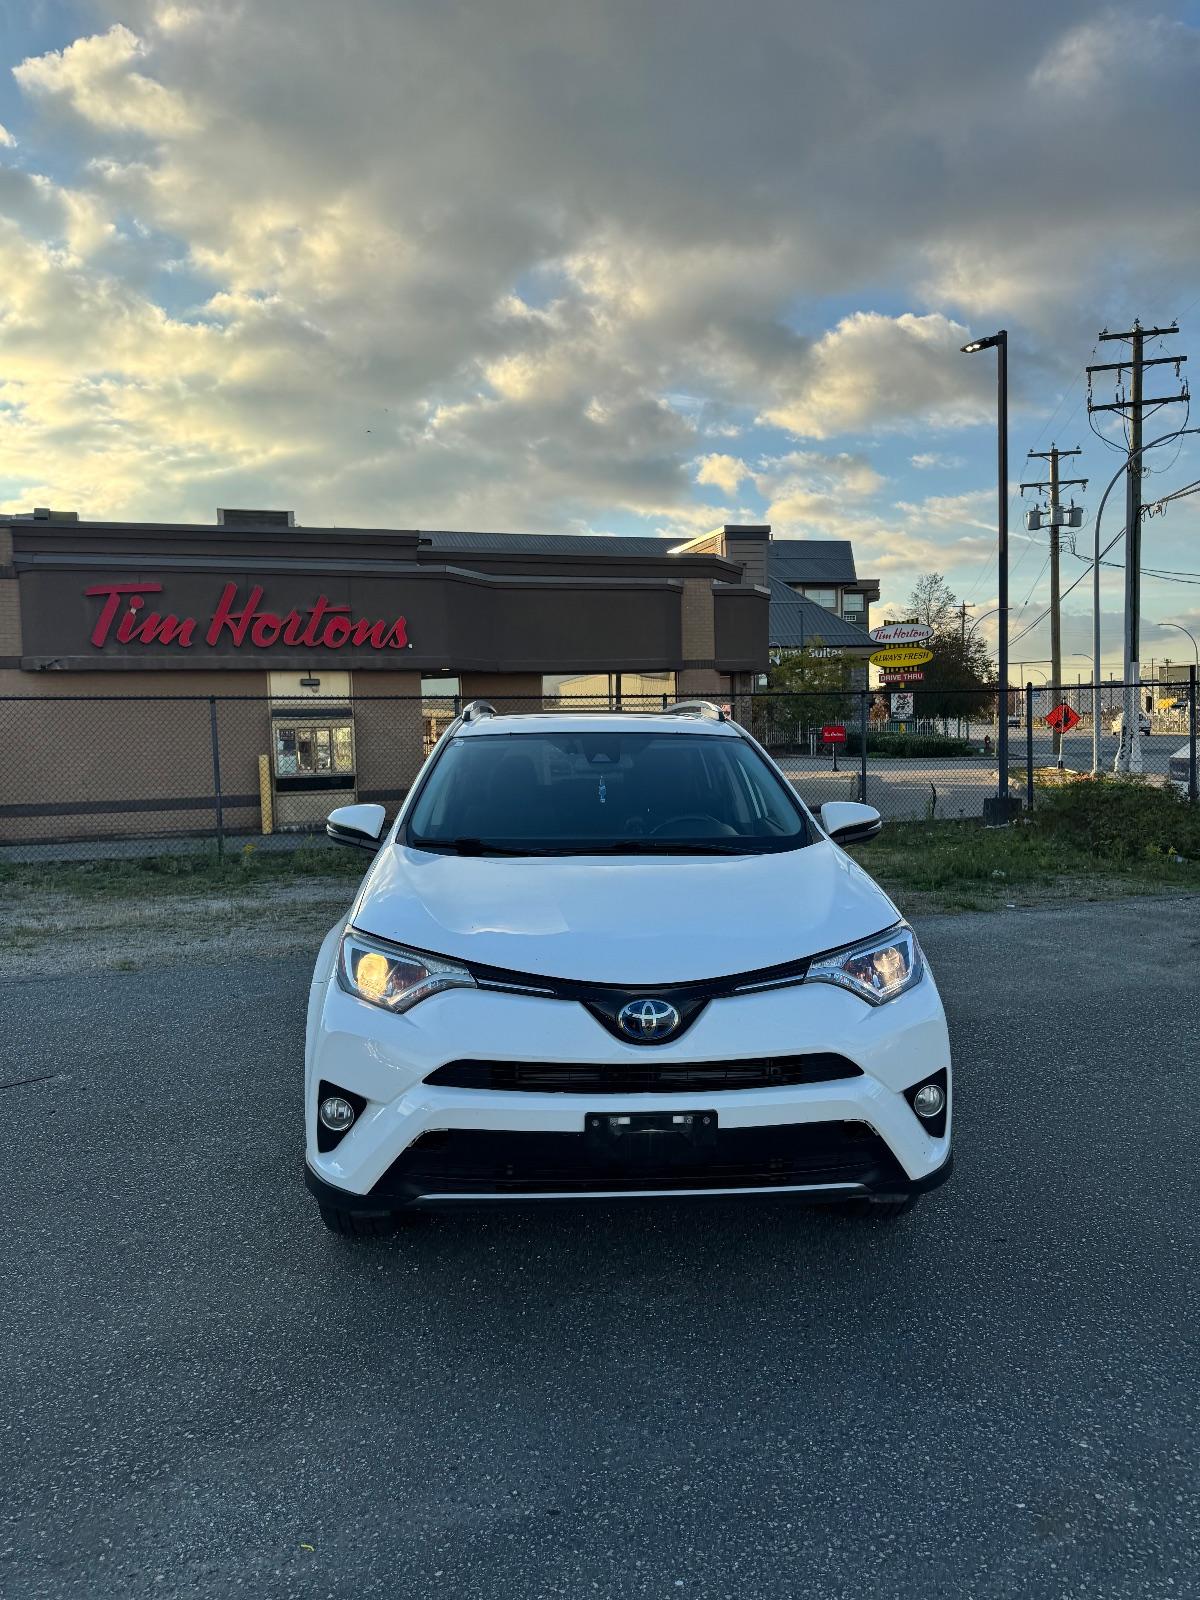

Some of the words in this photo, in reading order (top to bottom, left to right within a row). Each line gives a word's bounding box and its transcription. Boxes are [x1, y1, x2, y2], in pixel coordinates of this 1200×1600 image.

[85, 582, 198, 648] Tim
[205, 582, 408, 649] Hortons
[873, 629, 892, 640] Tim
[893, 627, 930, 639] Hortons
[873, 653, 903, 663] ALWAYS
[904, 651, 930, 661] FRESH
[880, 674, 902, 682] DRIVE
[903, 673, 923, 681] THRU
